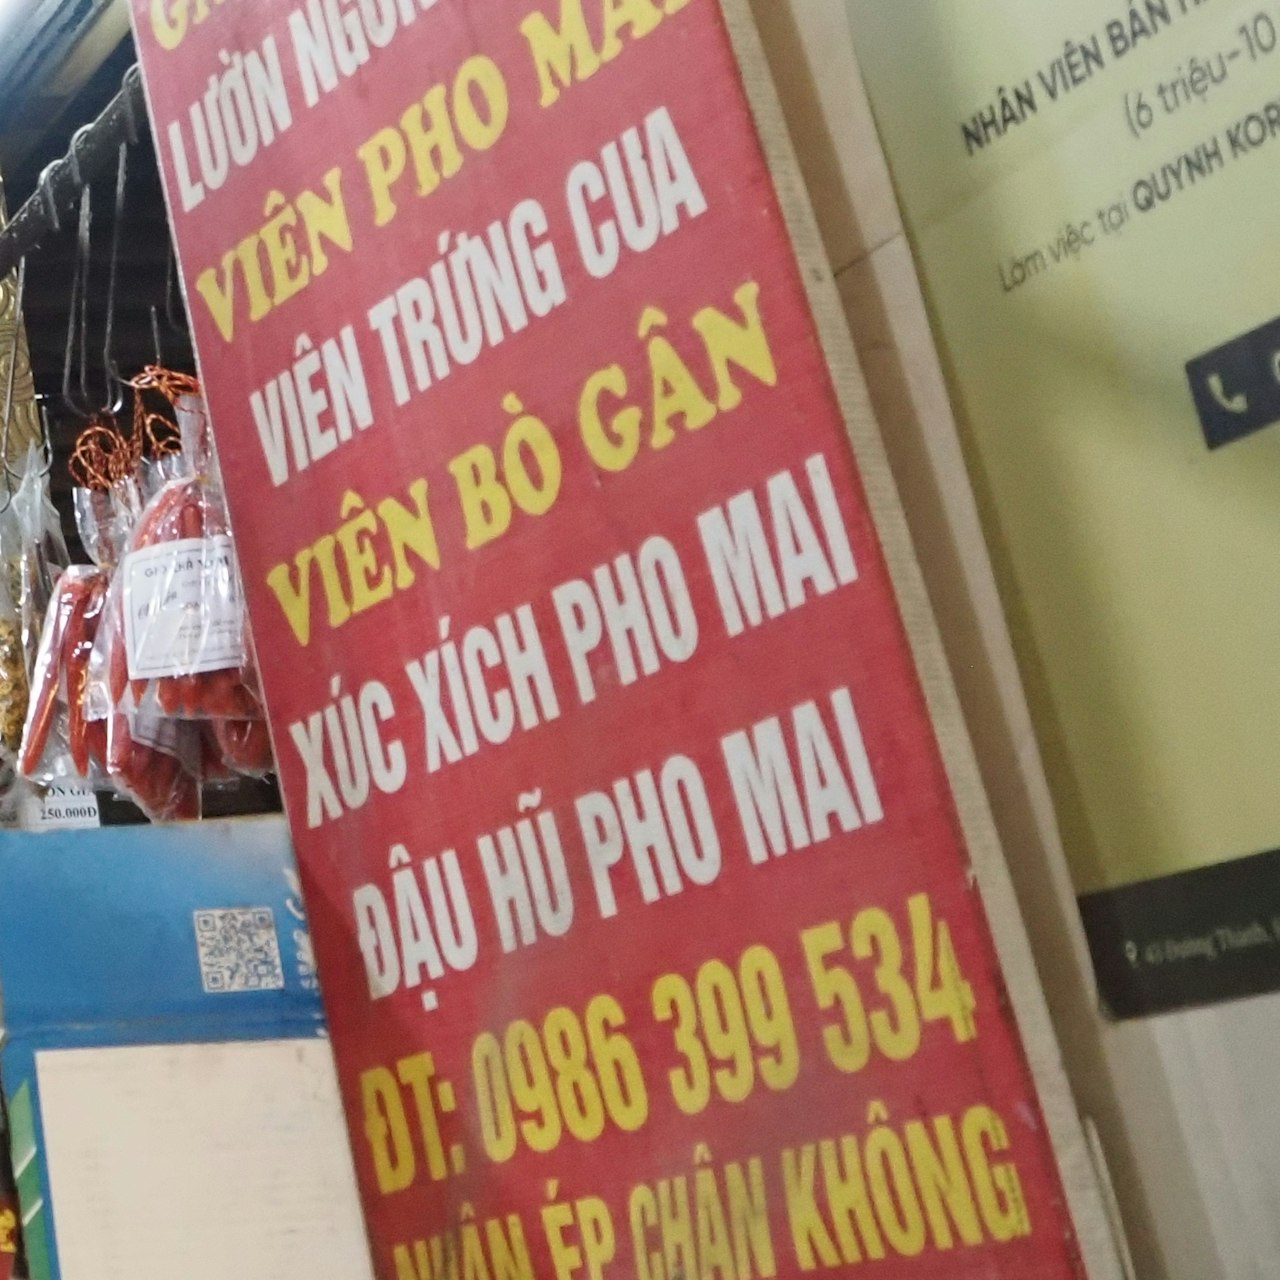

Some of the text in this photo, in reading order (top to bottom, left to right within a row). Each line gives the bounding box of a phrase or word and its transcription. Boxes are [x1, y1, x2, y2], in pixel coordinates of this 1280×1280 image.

[167, 48, 293, 213] LƯỜN
[195, 166, 353, 342] VIÊN
[357, 53, 509, 227] PHO
[960, 79, 1039, 156] NHÂN
[1037, 36, 1105, 102] VIÊN
[249, 105, 708, 488] VIÊN TRỨNG CUA
[266, 479, 439, 646] VIÊN
[449, 392, 563, 550] BÒ
[579, 281, 779, 472] GÂN
[289, 671, 410, 828] XÚC
[405, 614, 561, 774] XÍCH
[555, 535, 701, 705] PHO
[695, 452, 860, 638] MAI
[352, 844, 479, 1012] ĐẬU
[477, 784, 574, 954] HŨ
[574, 753, 722, 919] PHO
[721, 686, 884, 865] MAI
[360, 892, 977, 1195] ĐT: 0986 399 534
[541, 1178, 617, 1280] ÉP
[630, 1141, 768, 1280] CHÂN
[781, 1099, 1032, 1272] KHÔNG
